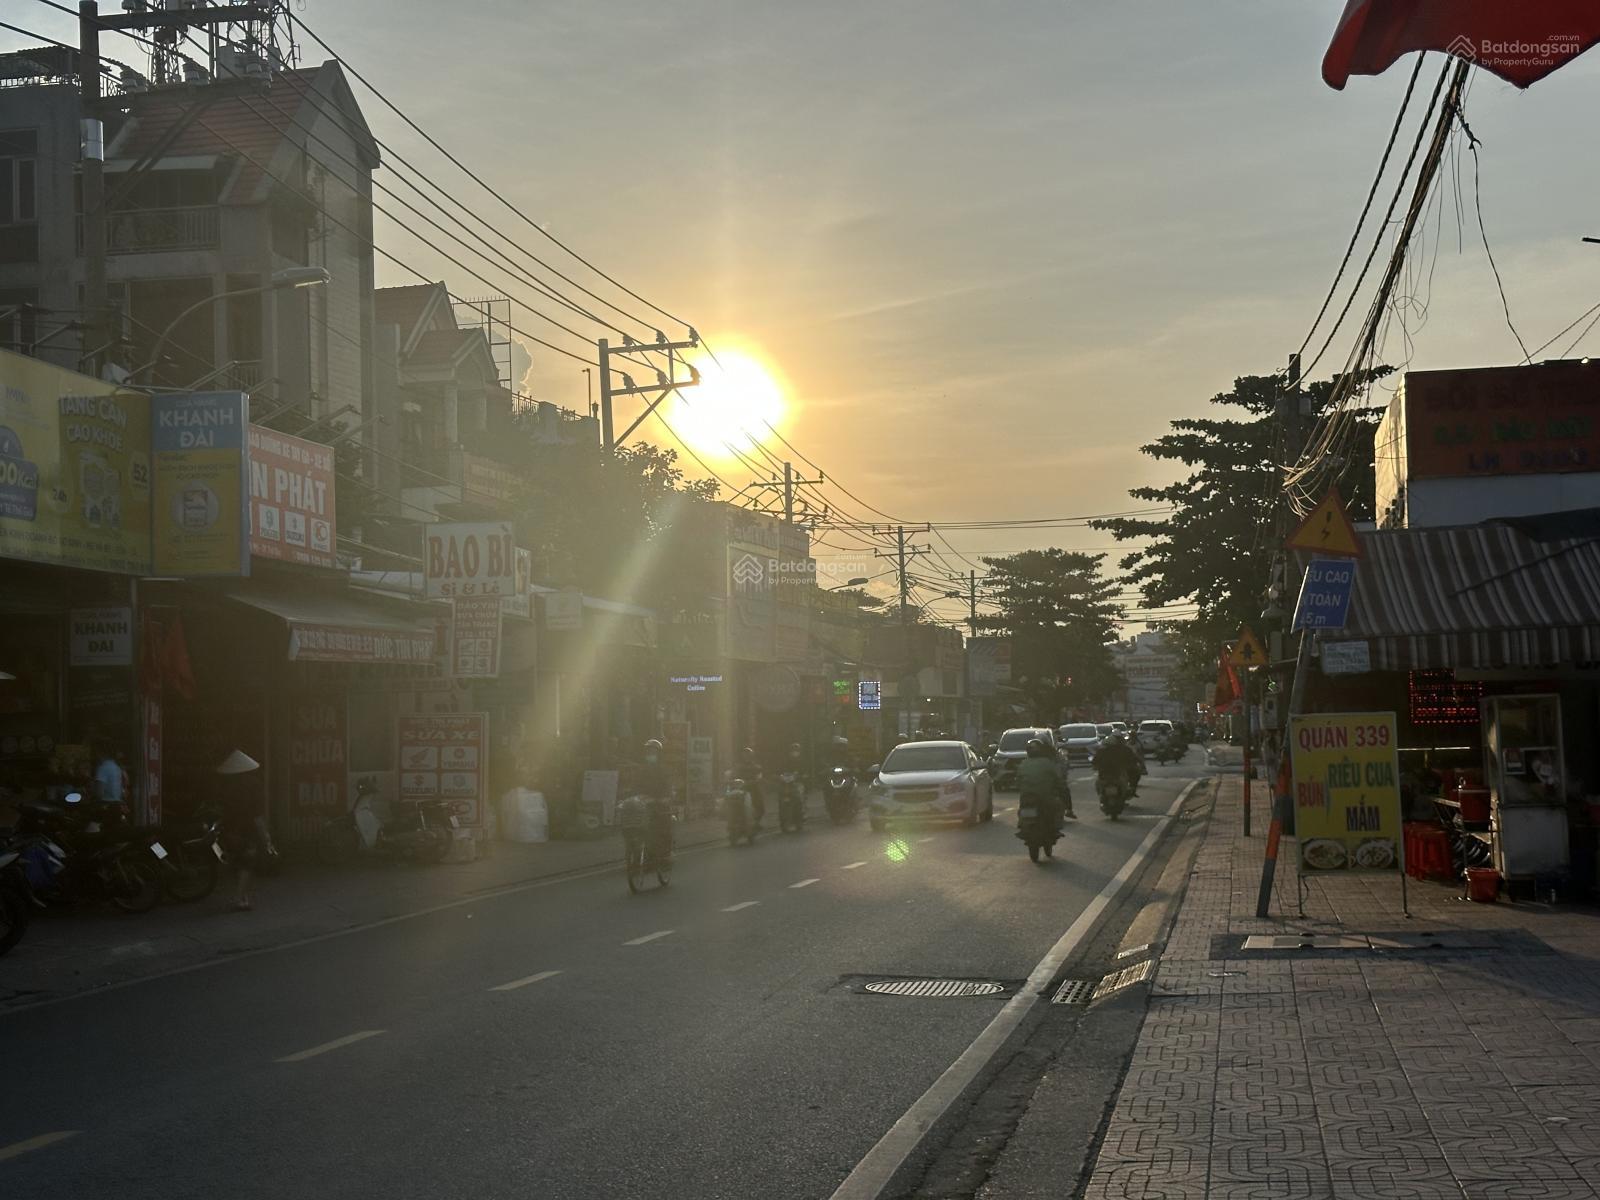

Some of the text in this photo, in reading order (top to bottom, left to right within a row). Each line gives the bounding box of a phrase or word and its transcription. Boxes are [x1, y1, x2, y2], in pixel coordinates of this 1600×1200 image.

[159, 407, 234, 427] KHANH
[133, 463, 148, 483] 52
[275, 469, 326, 515] PHÁT
[429, 534, 480, 577] BAO
[463, 583, 475, 594] &
[1325, 569, 1350, 584] CAO
[452, 730, 480, 740] XE
[1299, 721, 1390, 752] QUÁN 339
[1328, 755, 1394, 788] RIÊU CUA
[1297, 775, 1325, 808] BÚN
[1345, 794, 1381, 832] MẮM
